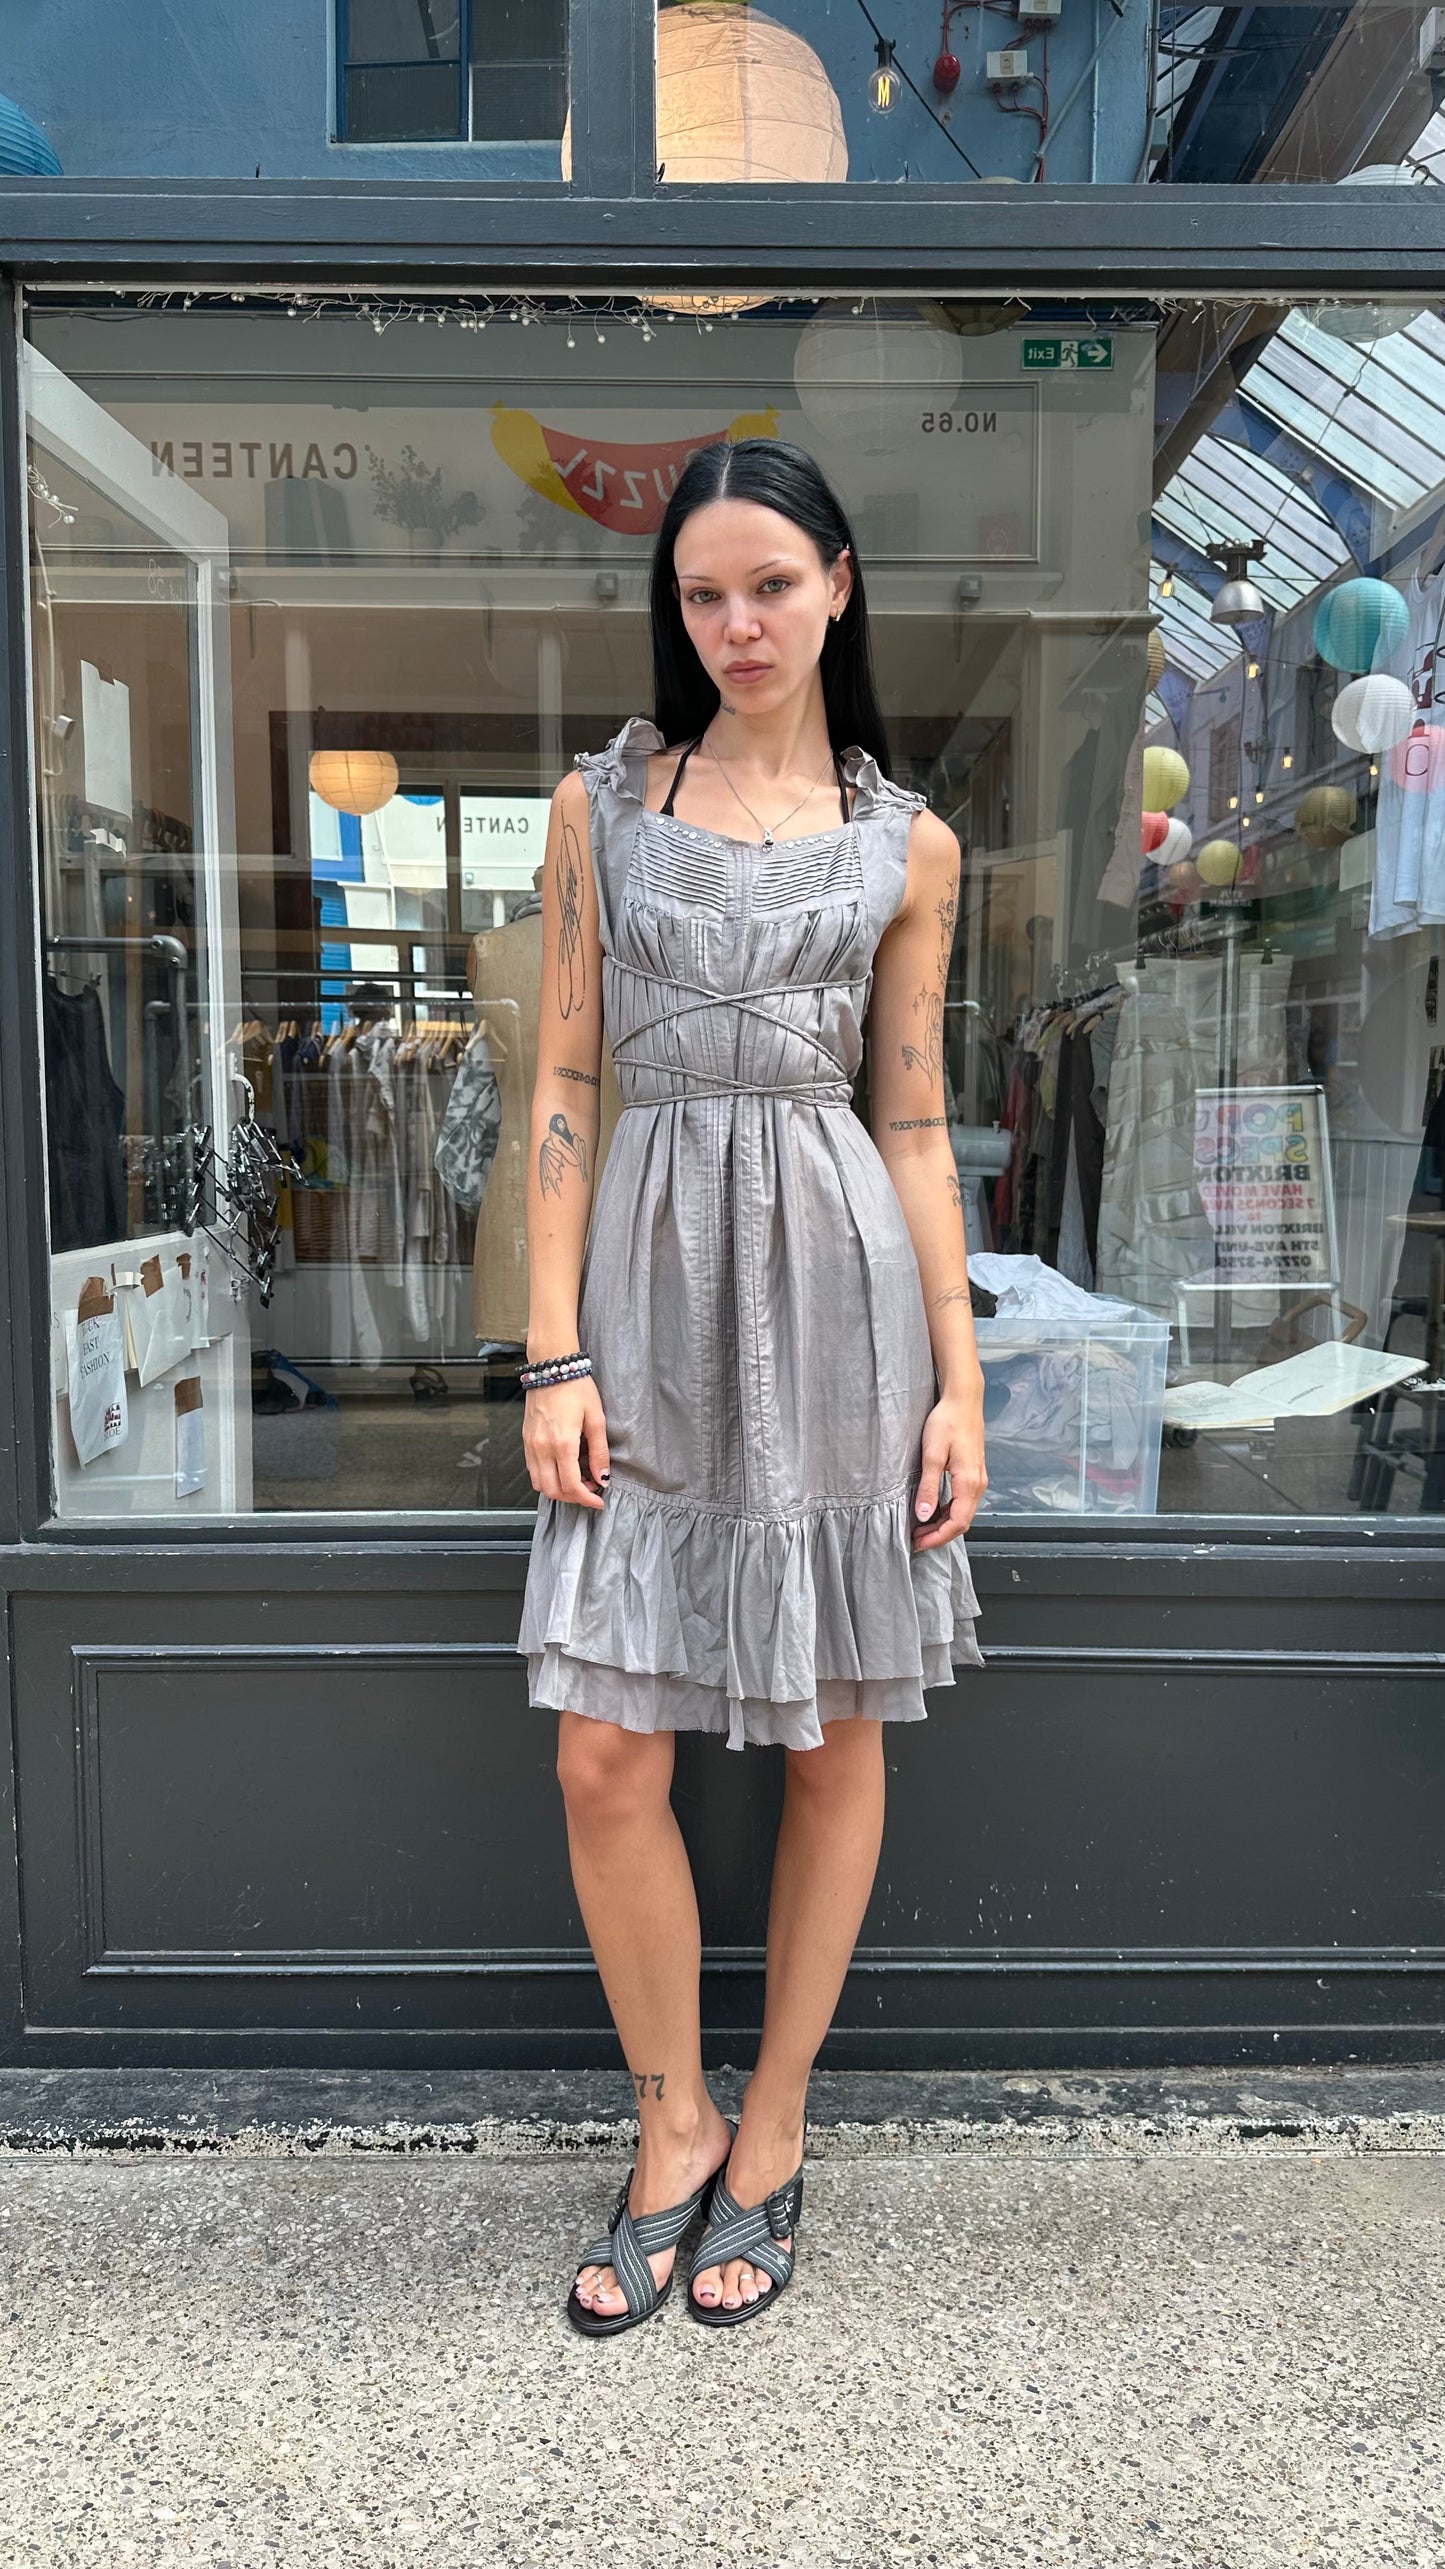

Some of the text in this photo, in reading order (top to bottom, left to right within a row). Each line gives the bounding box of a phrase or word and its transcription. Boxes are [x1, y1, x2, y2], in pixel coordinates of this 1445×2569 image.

[83, 1336, 99, 1356] FAST
[80, 1351, 110, 1379] FASHION
[634, 2072, 665, 2101] 77
